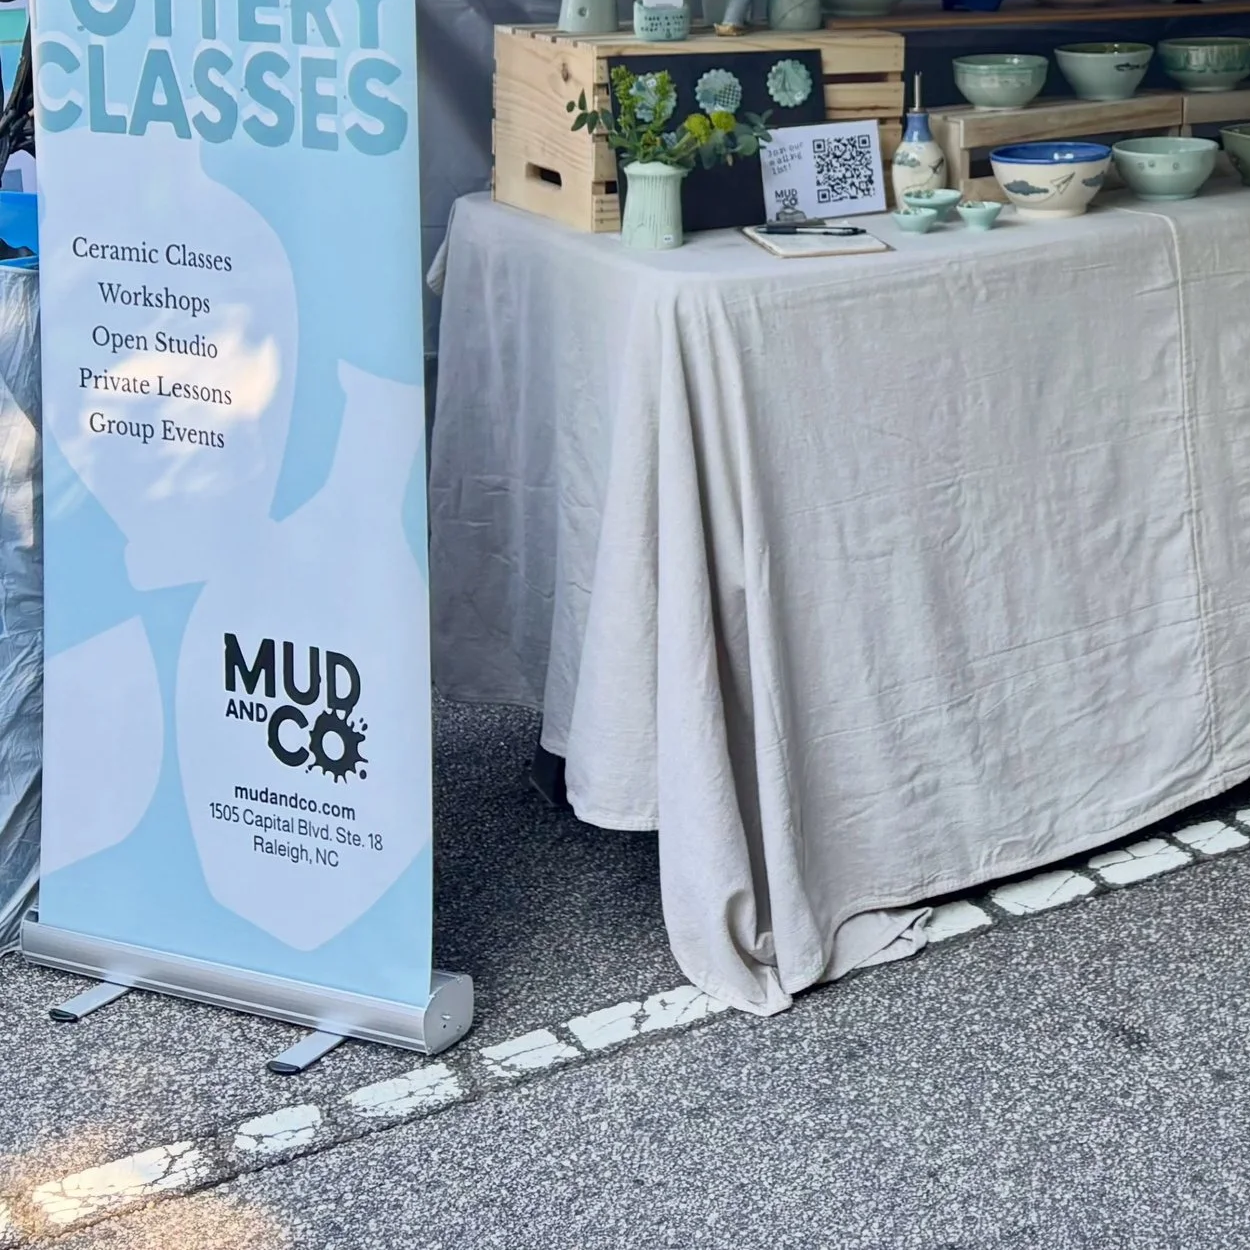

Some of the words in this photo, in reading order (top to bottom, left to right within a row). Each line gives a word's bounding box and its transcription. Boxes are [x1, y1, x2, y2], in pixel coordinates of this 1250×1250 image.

[36, 41, 409, 156] CLASSES
[774, 188, 798, 198] MUD
[71, 236, 159, 266] Ceramic
[165, 243, 233, 273] Classes
[97, 281, 211, 317] Workshops
[92, 324, 148, 354] Open
[154, 329, 219, 360] Studio
[78, 367, 151, 397] Private
[156, 374, 233, 407] Lessons
[89, 412, 155, 443] Group
[161, 420, 226, 449] Events
[223, 632, 361, 710] MUD
[225, 698, 268, 723] AND
[234, 785, 356, 821] mudandco.com
[209, 802, 240, 824] 1505
[243, 808, 294, 834] Capital
[298, 818, 333, 842] Blvd.
[336, 826, 365, 848] Ste.
[367, 833, 384, 851] 18
[253, 835, 313, 864] Raleigh,
[315, 848, 340, 868] NC
